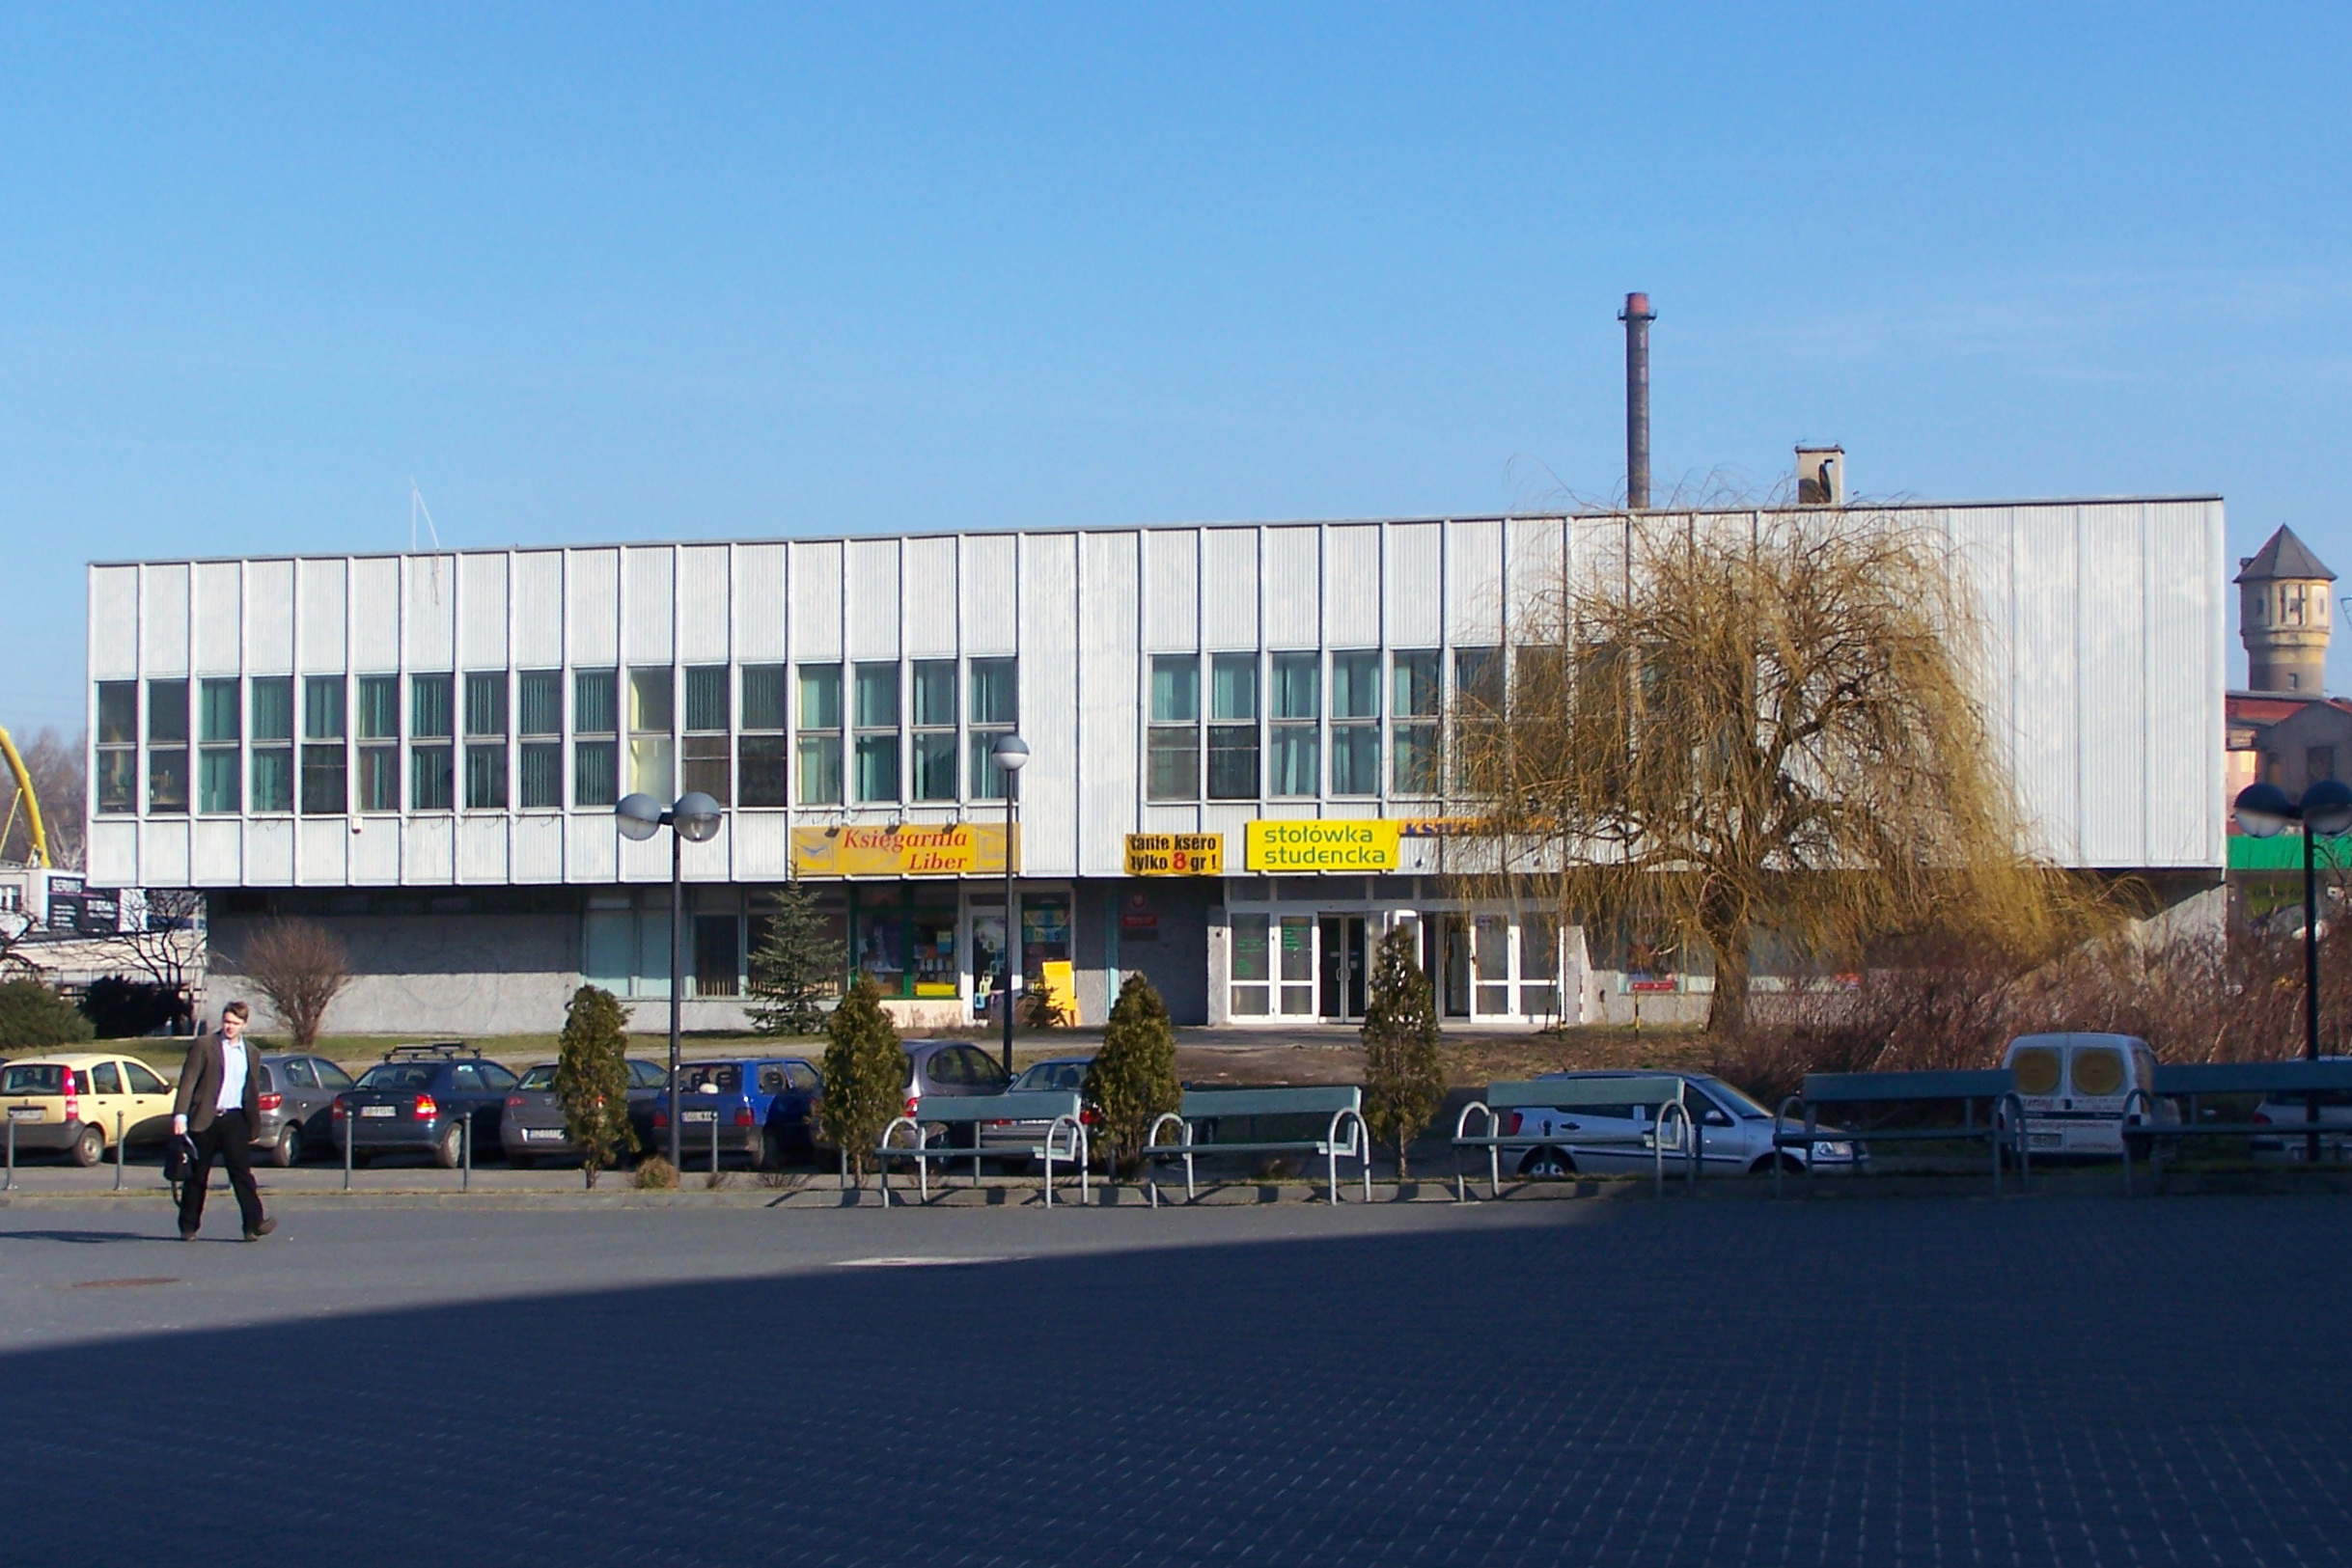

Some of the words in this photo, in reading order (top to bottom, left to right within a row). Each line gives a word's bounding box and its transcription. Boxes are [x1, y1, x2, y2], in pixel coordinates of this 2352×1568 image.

[844, 829, 967, 853] Księgarnia
[1131, 835, 1169, 850] tanie
[1175, 835, 1216, 850] ksero
[1264, 825, 1372, 843] stołówka
[910, 853, 967, 870] Liber
[1131, 854, 1168, 870] tylko
[1173, 851, 1187, 870] 8
[1190, 857, 1206, 871] gr
[1264, 846, 1385, 865] studencka
